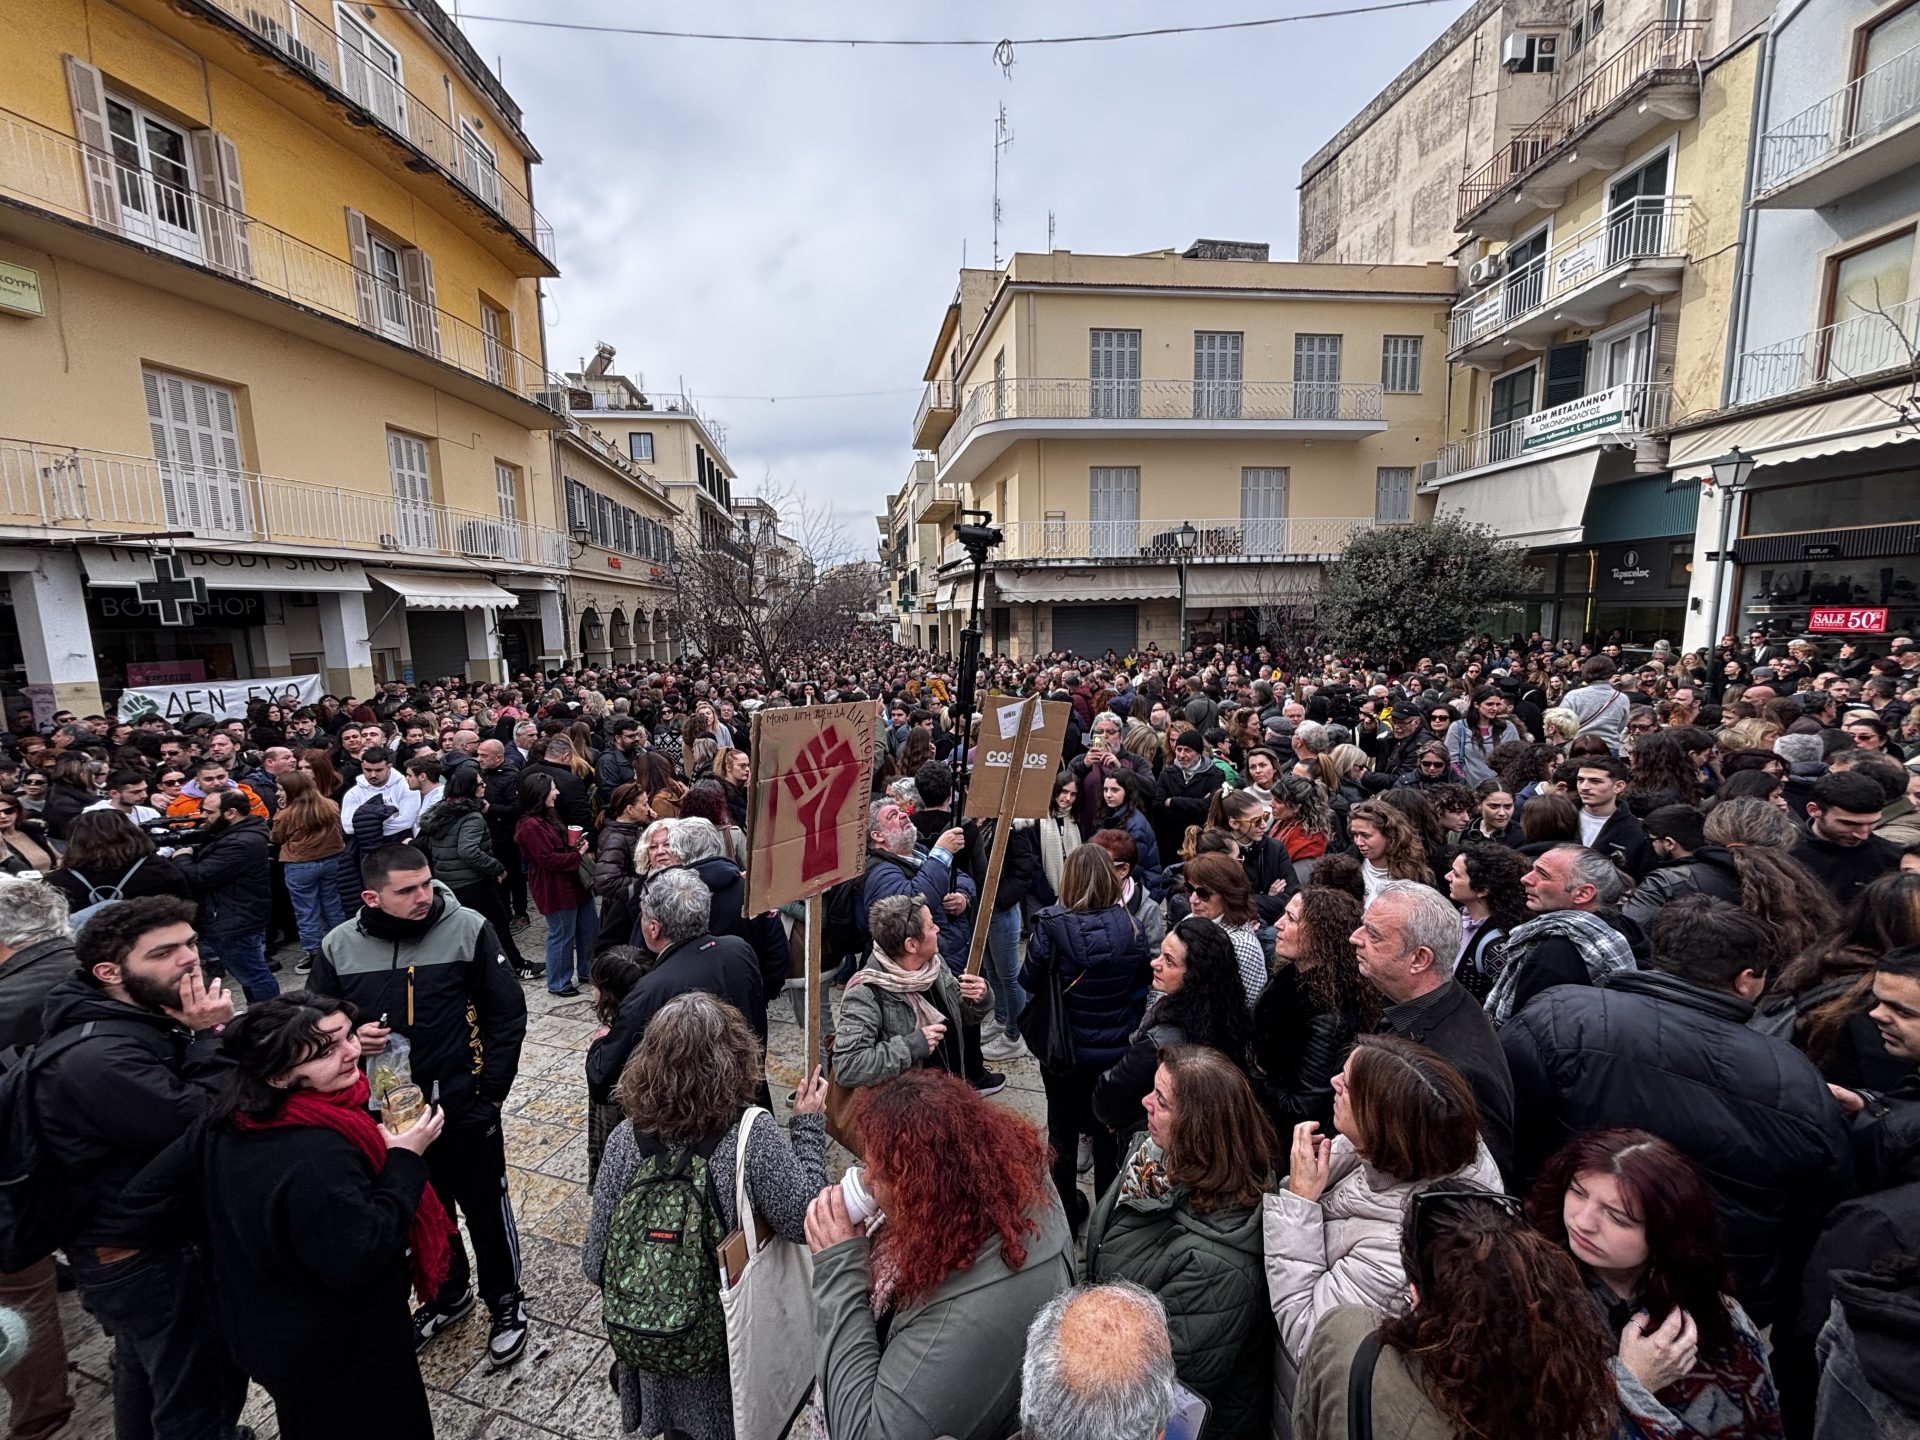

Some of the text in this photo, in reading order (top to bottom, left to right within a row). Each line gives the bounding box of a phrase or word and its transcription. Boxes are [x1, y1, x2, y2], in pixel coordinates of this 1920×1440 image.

[1531, 391, 1614, 425] ΖΩΗ ΜΕΤΑΛΛΗΝΟΥ
[193, 597, 257, 616] SHOP
[1814, 613, 1845, 624] SALE
[165, 689, 227, 718] ΔΕΝ
[766, 713, 789, 726] ΜΟΝΟ
